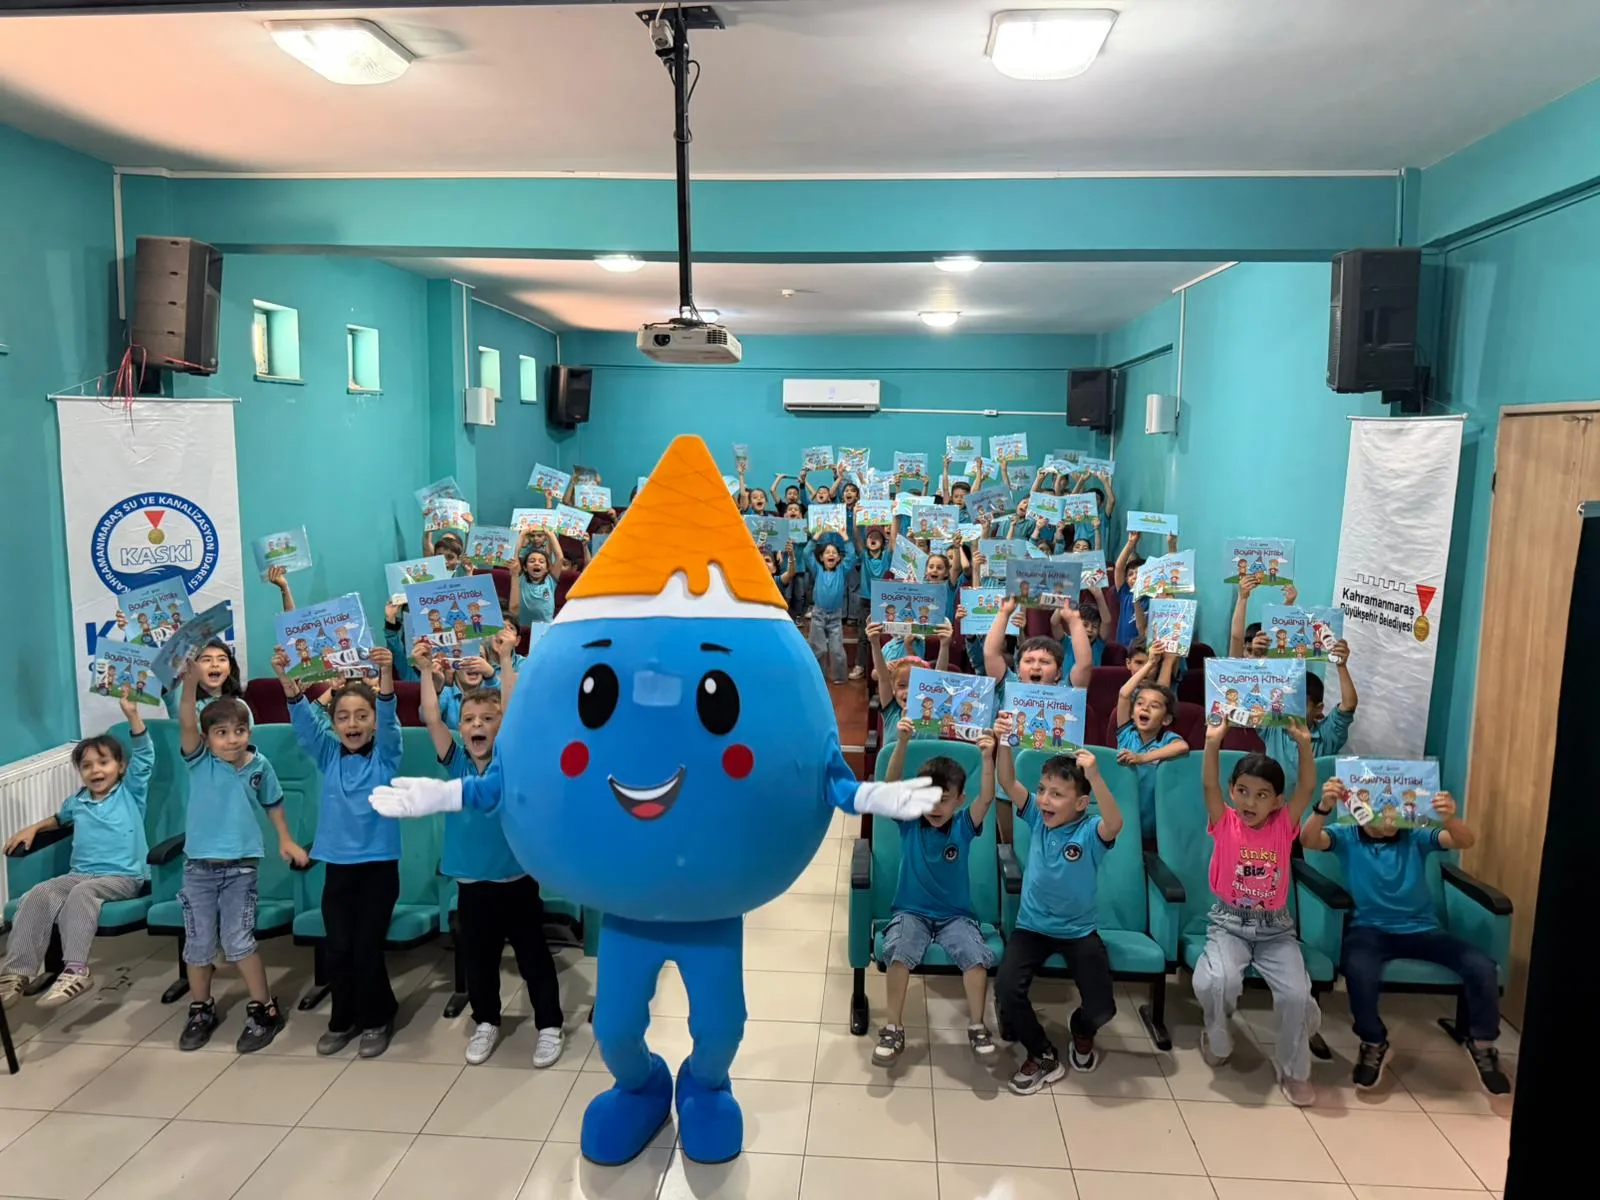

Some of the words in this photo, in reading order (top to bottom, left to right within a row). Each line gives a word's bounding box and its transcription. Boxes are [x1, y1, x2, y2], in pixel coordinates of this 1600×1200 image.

[96, 509, 131, 593] KAHRAMANMARAŞ
[122, 500, 138, 512] SU
[140, 496, 155, 504] VE
[159, 496, 214, 550] KANALİZASYON
[187, 553, 216, 590] İDARESİ
[120, 539, 192, 566] KASKİ
[419, 592, 456, 605] Boyama
[1342, 587, 1414, 619] Kahramanmaraş
[285, 620, 321, 636] Boyama
[1272, 616, 1304, 626] Boyama
[1379, 612, 1413, 633] Belediyesi
[1219, 674, 1259, 684] Boyama
[1013, 697, 1044, 708] Boyama
[1047, 701, 1072, 711] Kitabı
[1243, 865, 1265, 877] Biz
